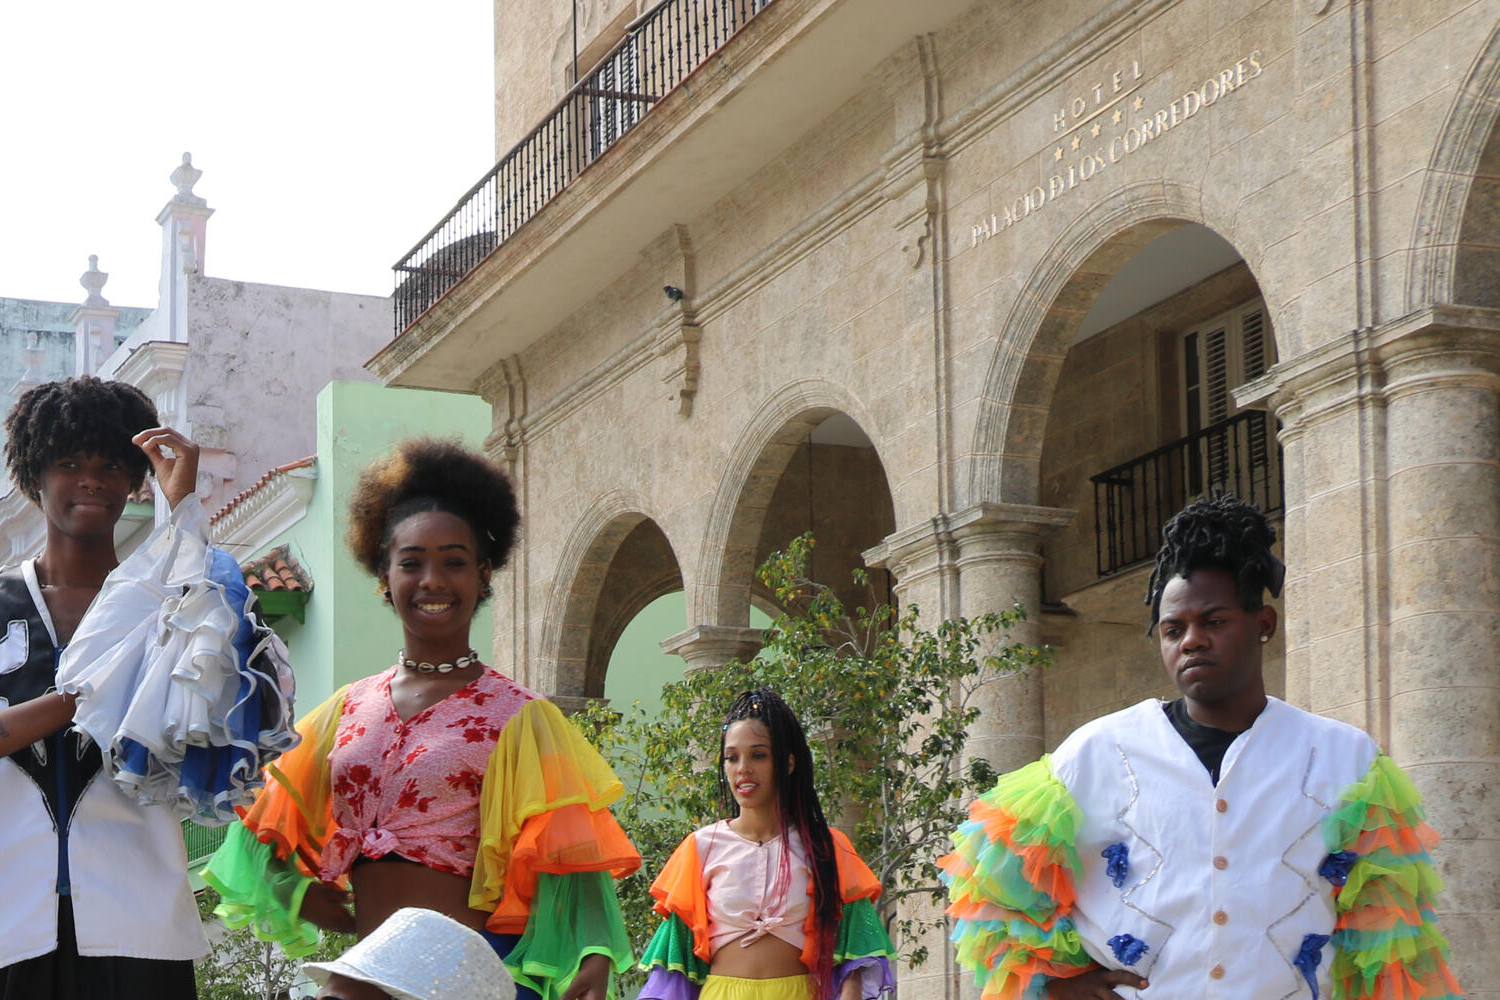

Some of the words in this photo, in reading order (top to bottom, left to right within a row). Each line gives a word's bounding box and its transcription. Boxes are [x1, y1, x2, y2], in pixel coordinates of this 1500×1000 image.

[971, 186, 1045, 249] PALACIO
[1068, 147, 1106, 189] LOS
[1109, 50, 1262, 164] CORREDORES
[1053, 60, 1143, 132] HOTEL
